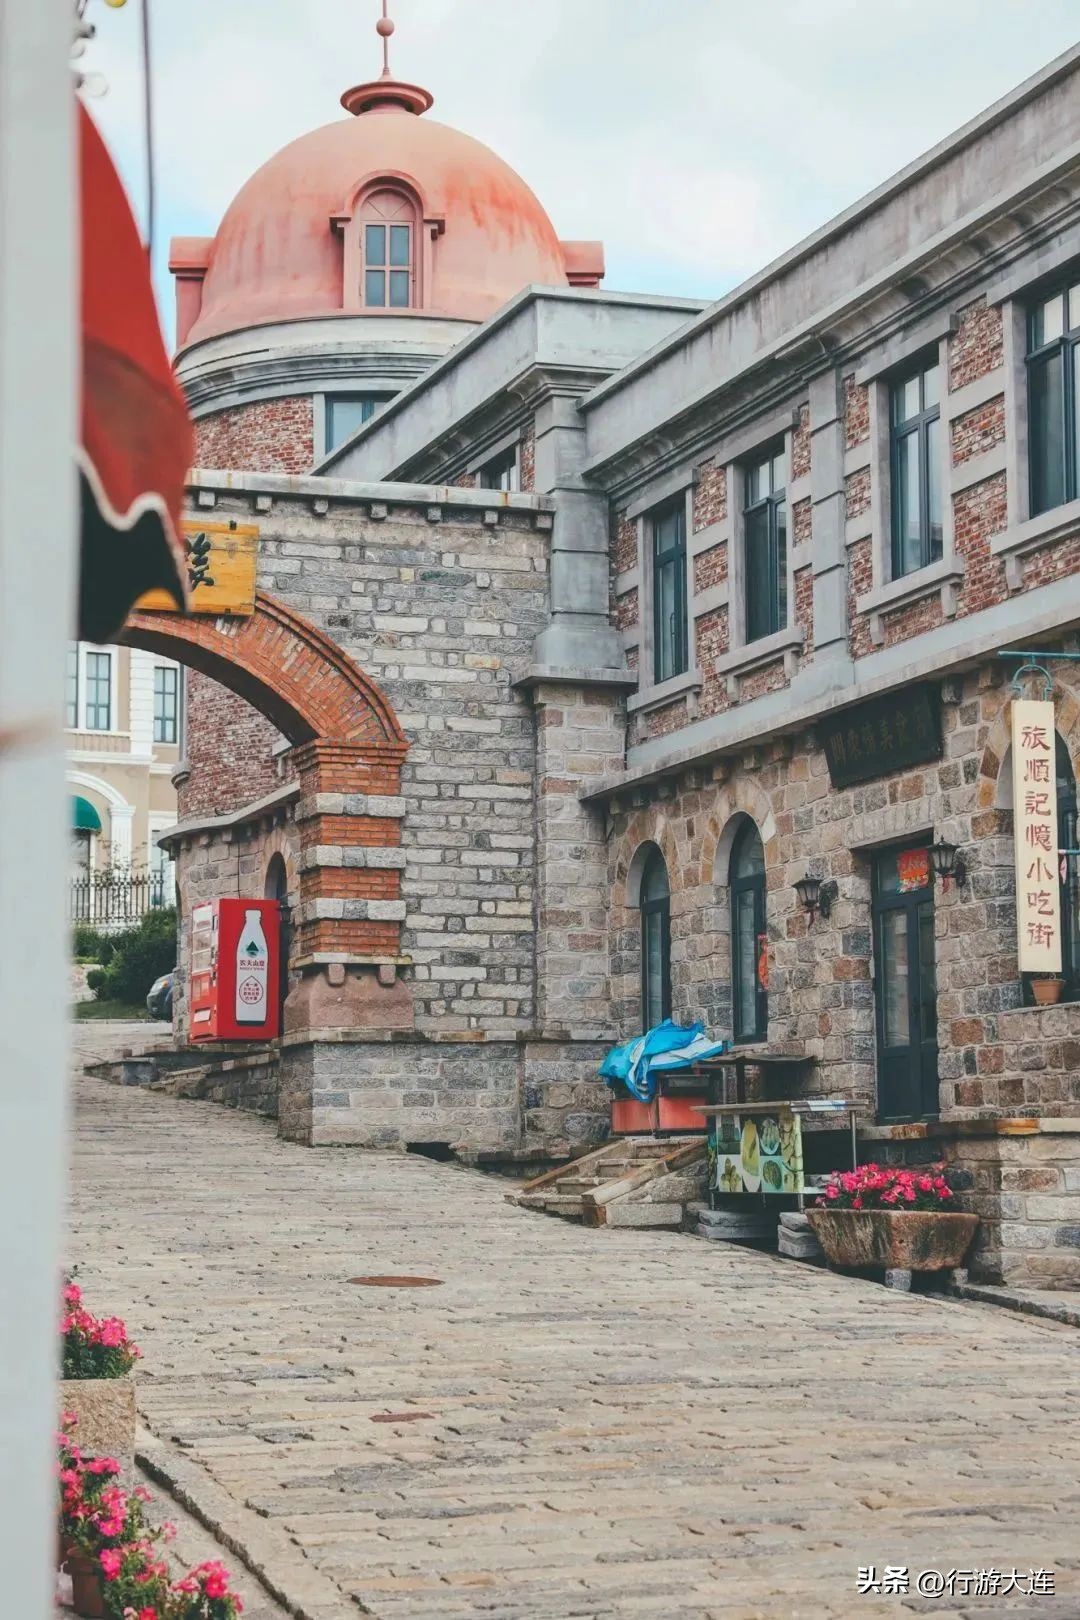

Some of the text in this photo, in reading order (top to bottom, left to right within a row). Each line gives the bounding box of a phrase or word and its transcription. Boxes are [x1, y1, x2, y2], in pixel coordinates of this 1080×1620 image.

[1021, 726, 1054, 949] 旅順記憶小吃街
